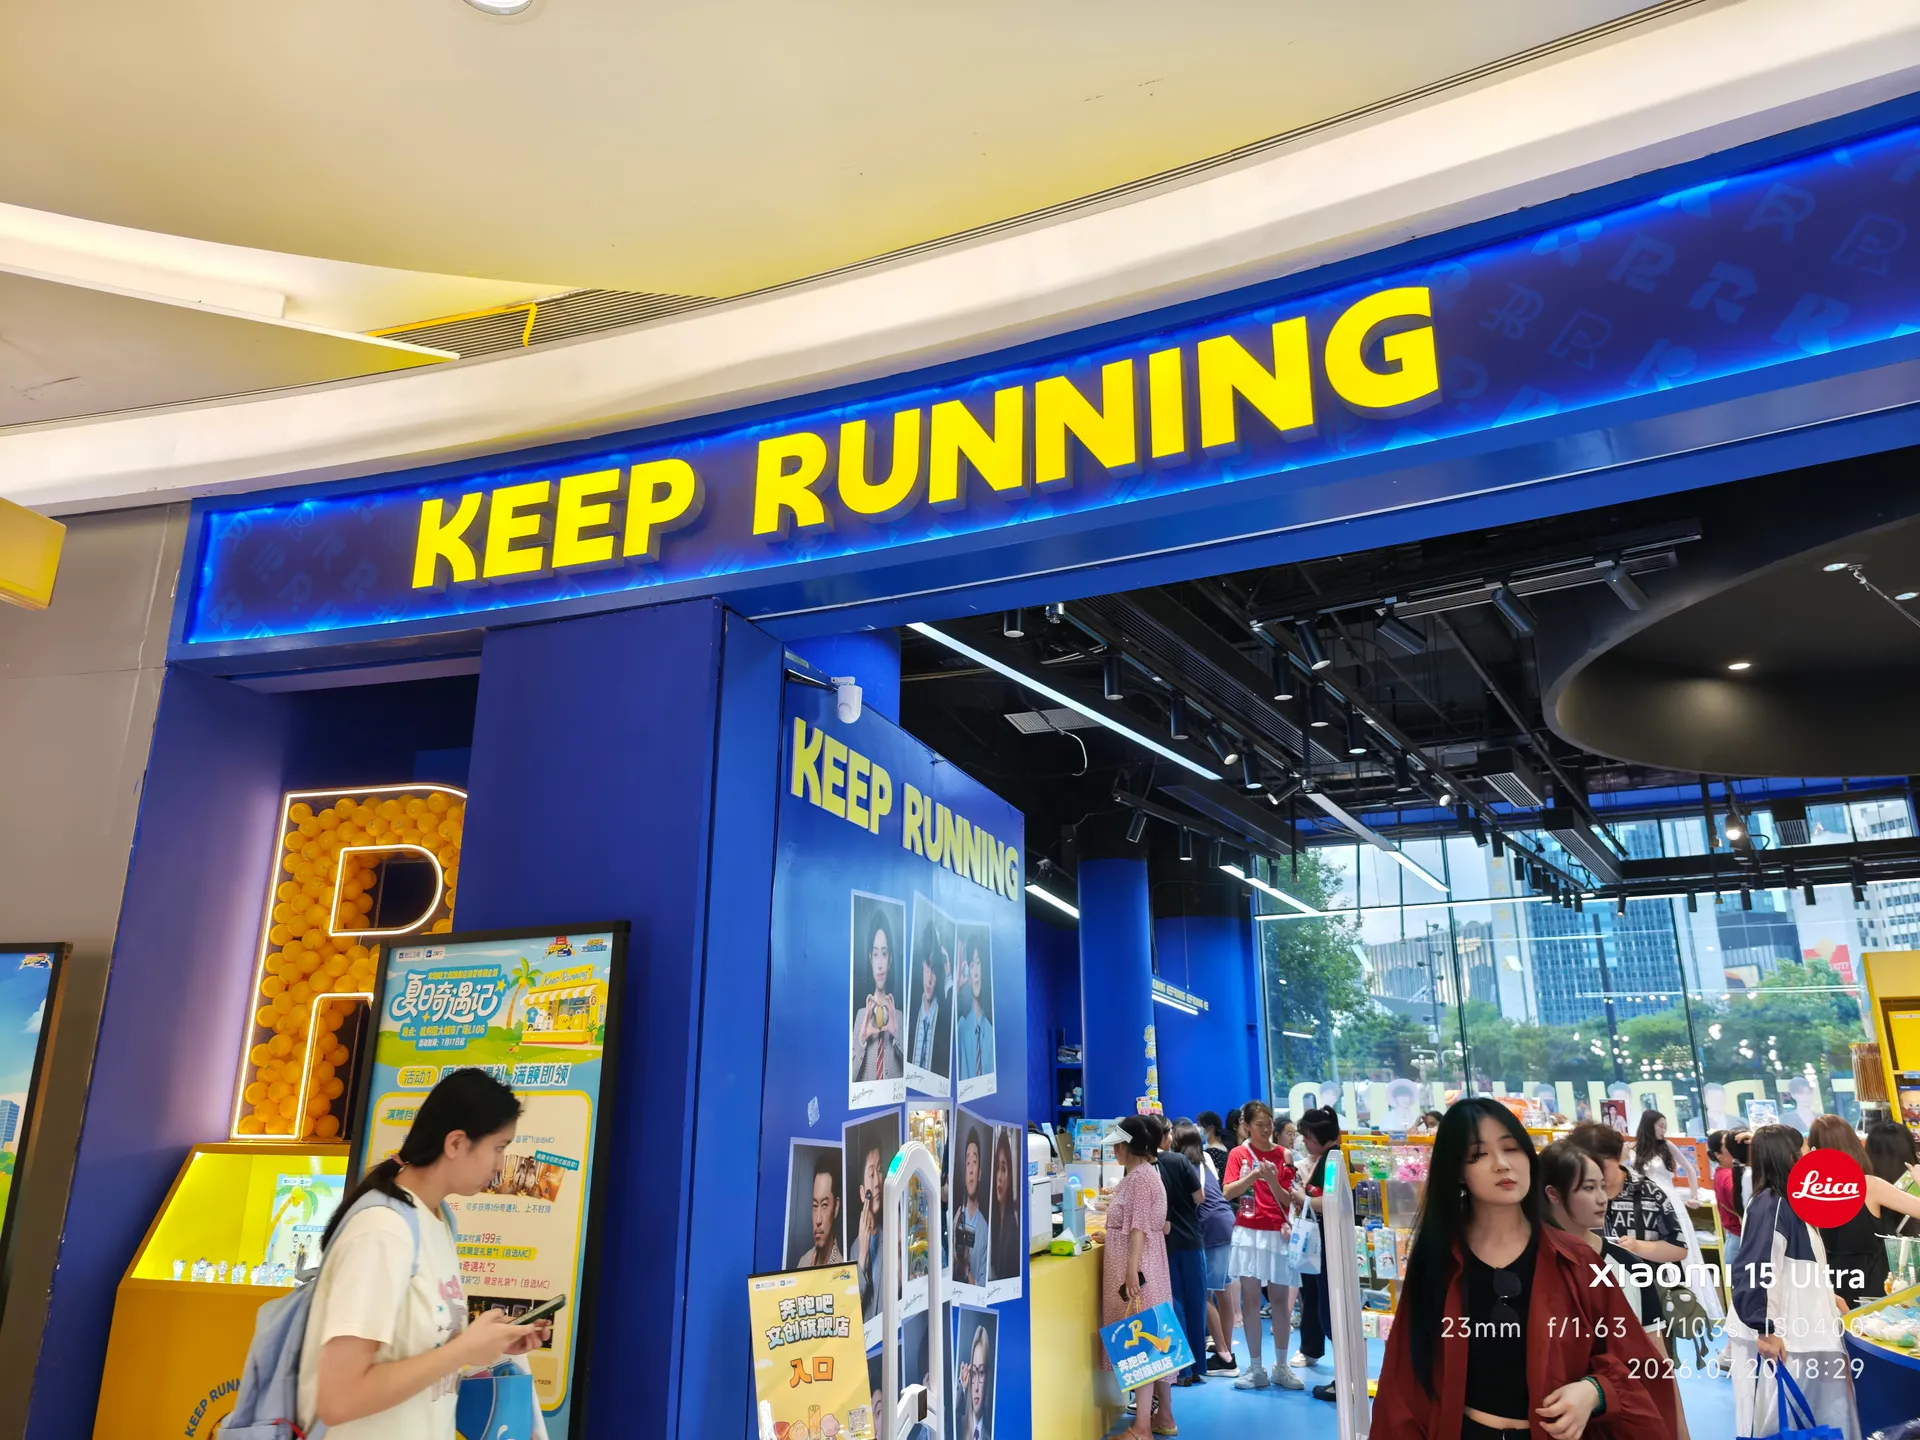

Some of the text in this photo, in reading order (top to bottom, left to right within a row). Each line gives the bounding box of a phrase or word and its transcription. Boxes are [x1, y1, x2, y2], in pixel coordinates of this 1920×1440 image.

[411, 286, 1440, 589] KEEP RUNNING
[791, 716, 1019, 902] KEEP RUNNING
[391, 973, 499, 1023] 夏日奇遇记
[403, 1070, 432, 1084] 活动1
[512, 1064, 570, 1085] 满额即领
[779, 1294, 834, 1321] 奔跑吧
[765, 1316, 851, 1350] 文创旗舰店
[789, 1356, 834, 1388] 入口
[185, 1399, 208, 1437] KEEP
